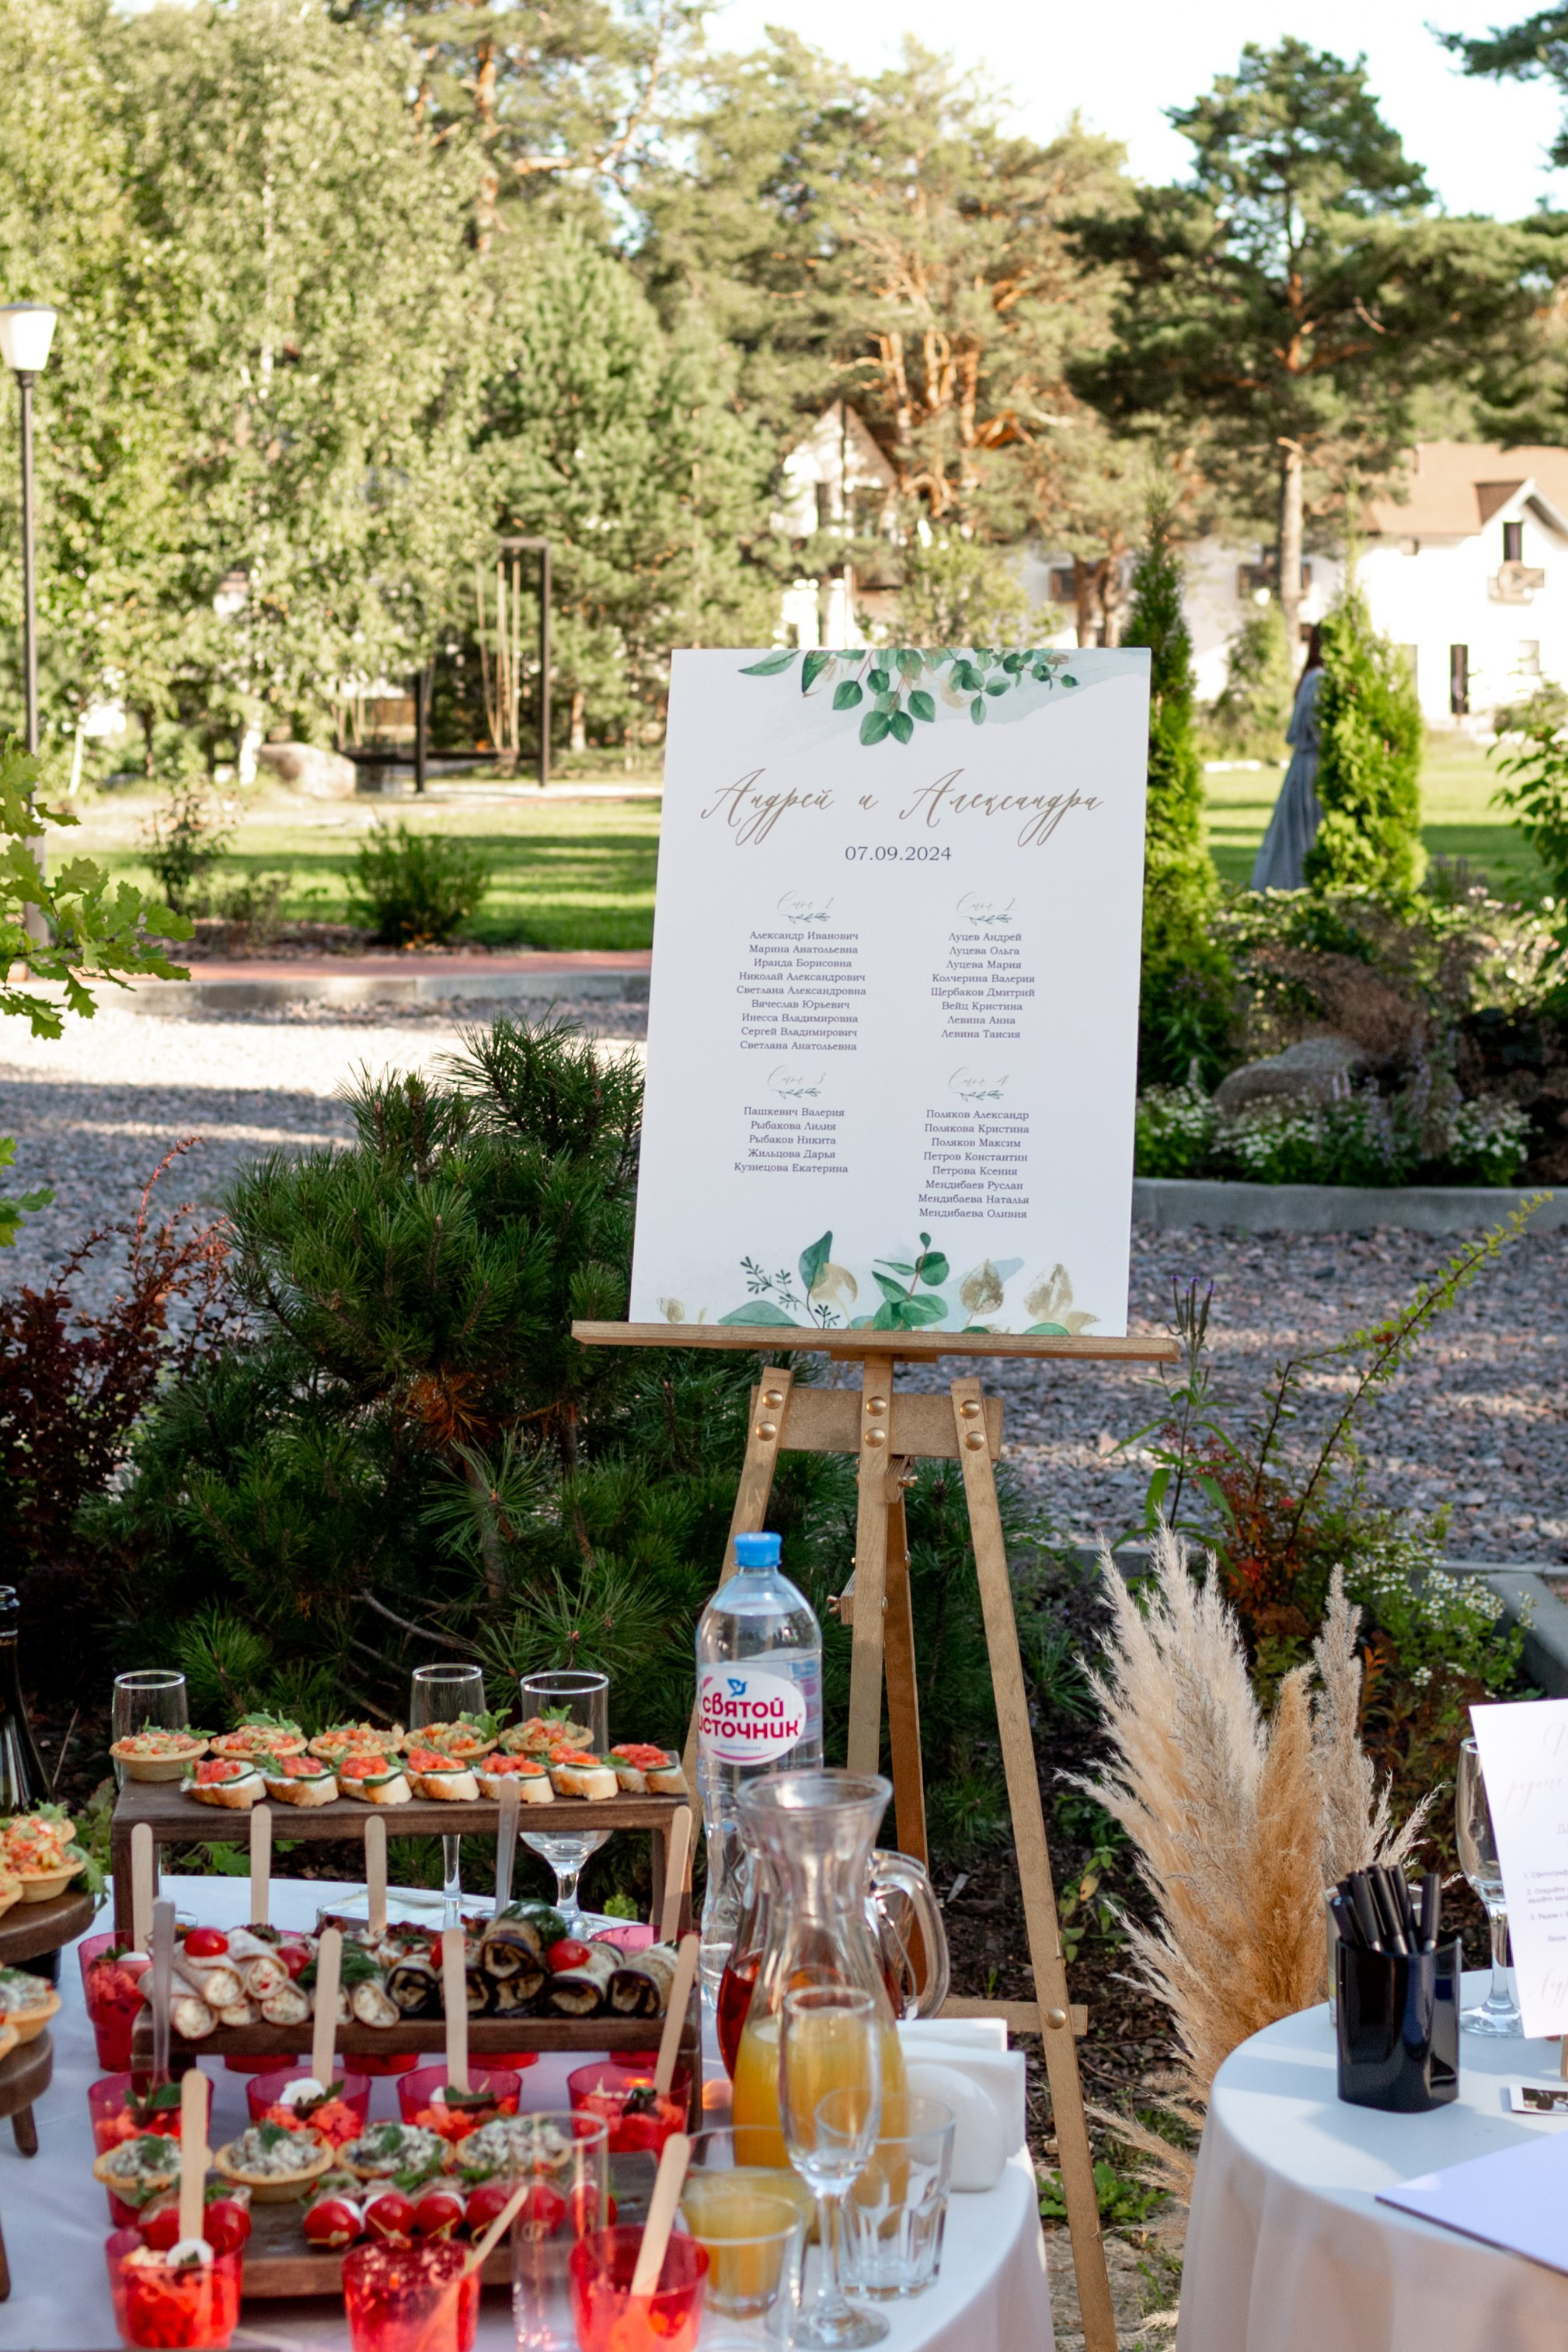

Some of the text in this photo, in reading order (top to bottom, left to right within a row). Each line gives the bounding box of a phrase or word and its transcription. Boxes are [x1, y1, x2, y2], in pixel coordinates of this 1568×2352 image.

[701, 768, 1105, 847] Андрей и Александра
[845, 845, 953, 862] 07.09.2024
[750, 931, 804, 942] Александр
[949, 932, 1021, 943] Луцев Андрей
[749, 945, 789, 955] Марина
[950, 946, 1019, 956] Луцева Ольга
[754, 958, 852, 969] Ираида Борисовна
[946, 960, 1021, 970] Луцева Мария
[740, 972, 865, 983] Николай Александрович
[932, 974, 1034, 984] Колчерина Валерия
[737, 985, 866, 997] Светлана Александровна
[931, 988, 1034, 998] Щербаков Дмитрий
[752, 999, 849, 1010] Вячеслав Юрьевич
[943, 1002, 1023, 1012] Вейц Кристина
[782, 1014, 858, 1025] Владимировна
[947, 1016, 985, 1024] Левина
[741, 1027, 857, 1038] Сергей Владимирович
[983, 1030, 1020, 1038] Таисия
[740, 1040, 857, 1051] Светлана Анатольевна
[744, 1106, 845, 1118] Пашкевич Валерия
[927, 1110, 1029, 1121] Поляков Александр
[751, 1120, 836, 1131] Рыбакова Лилия
[925, 1124, 1030, 1135] Полякова Кристина
[749, 1134, 836, 1145] Рыбаков Никита
[932, 1138, 1021, 1147] Поляков Максим
[748, 1148, 835, 1160] Жильцова Дарья
[924, 1152, 1027, 1162] Петров Константин
[734, 1162, 848, 1175] Кузнецова Екатерина
[932, 1166, 1017, 1176] Петрова Ксения
[926, 1180, 1023, 1191] Мендибаев Руслан
[918, 1194, 1029, 1204] Мендибаева Наталья
[919, 1208, 1026, 1218] Мендибаева Оливия
